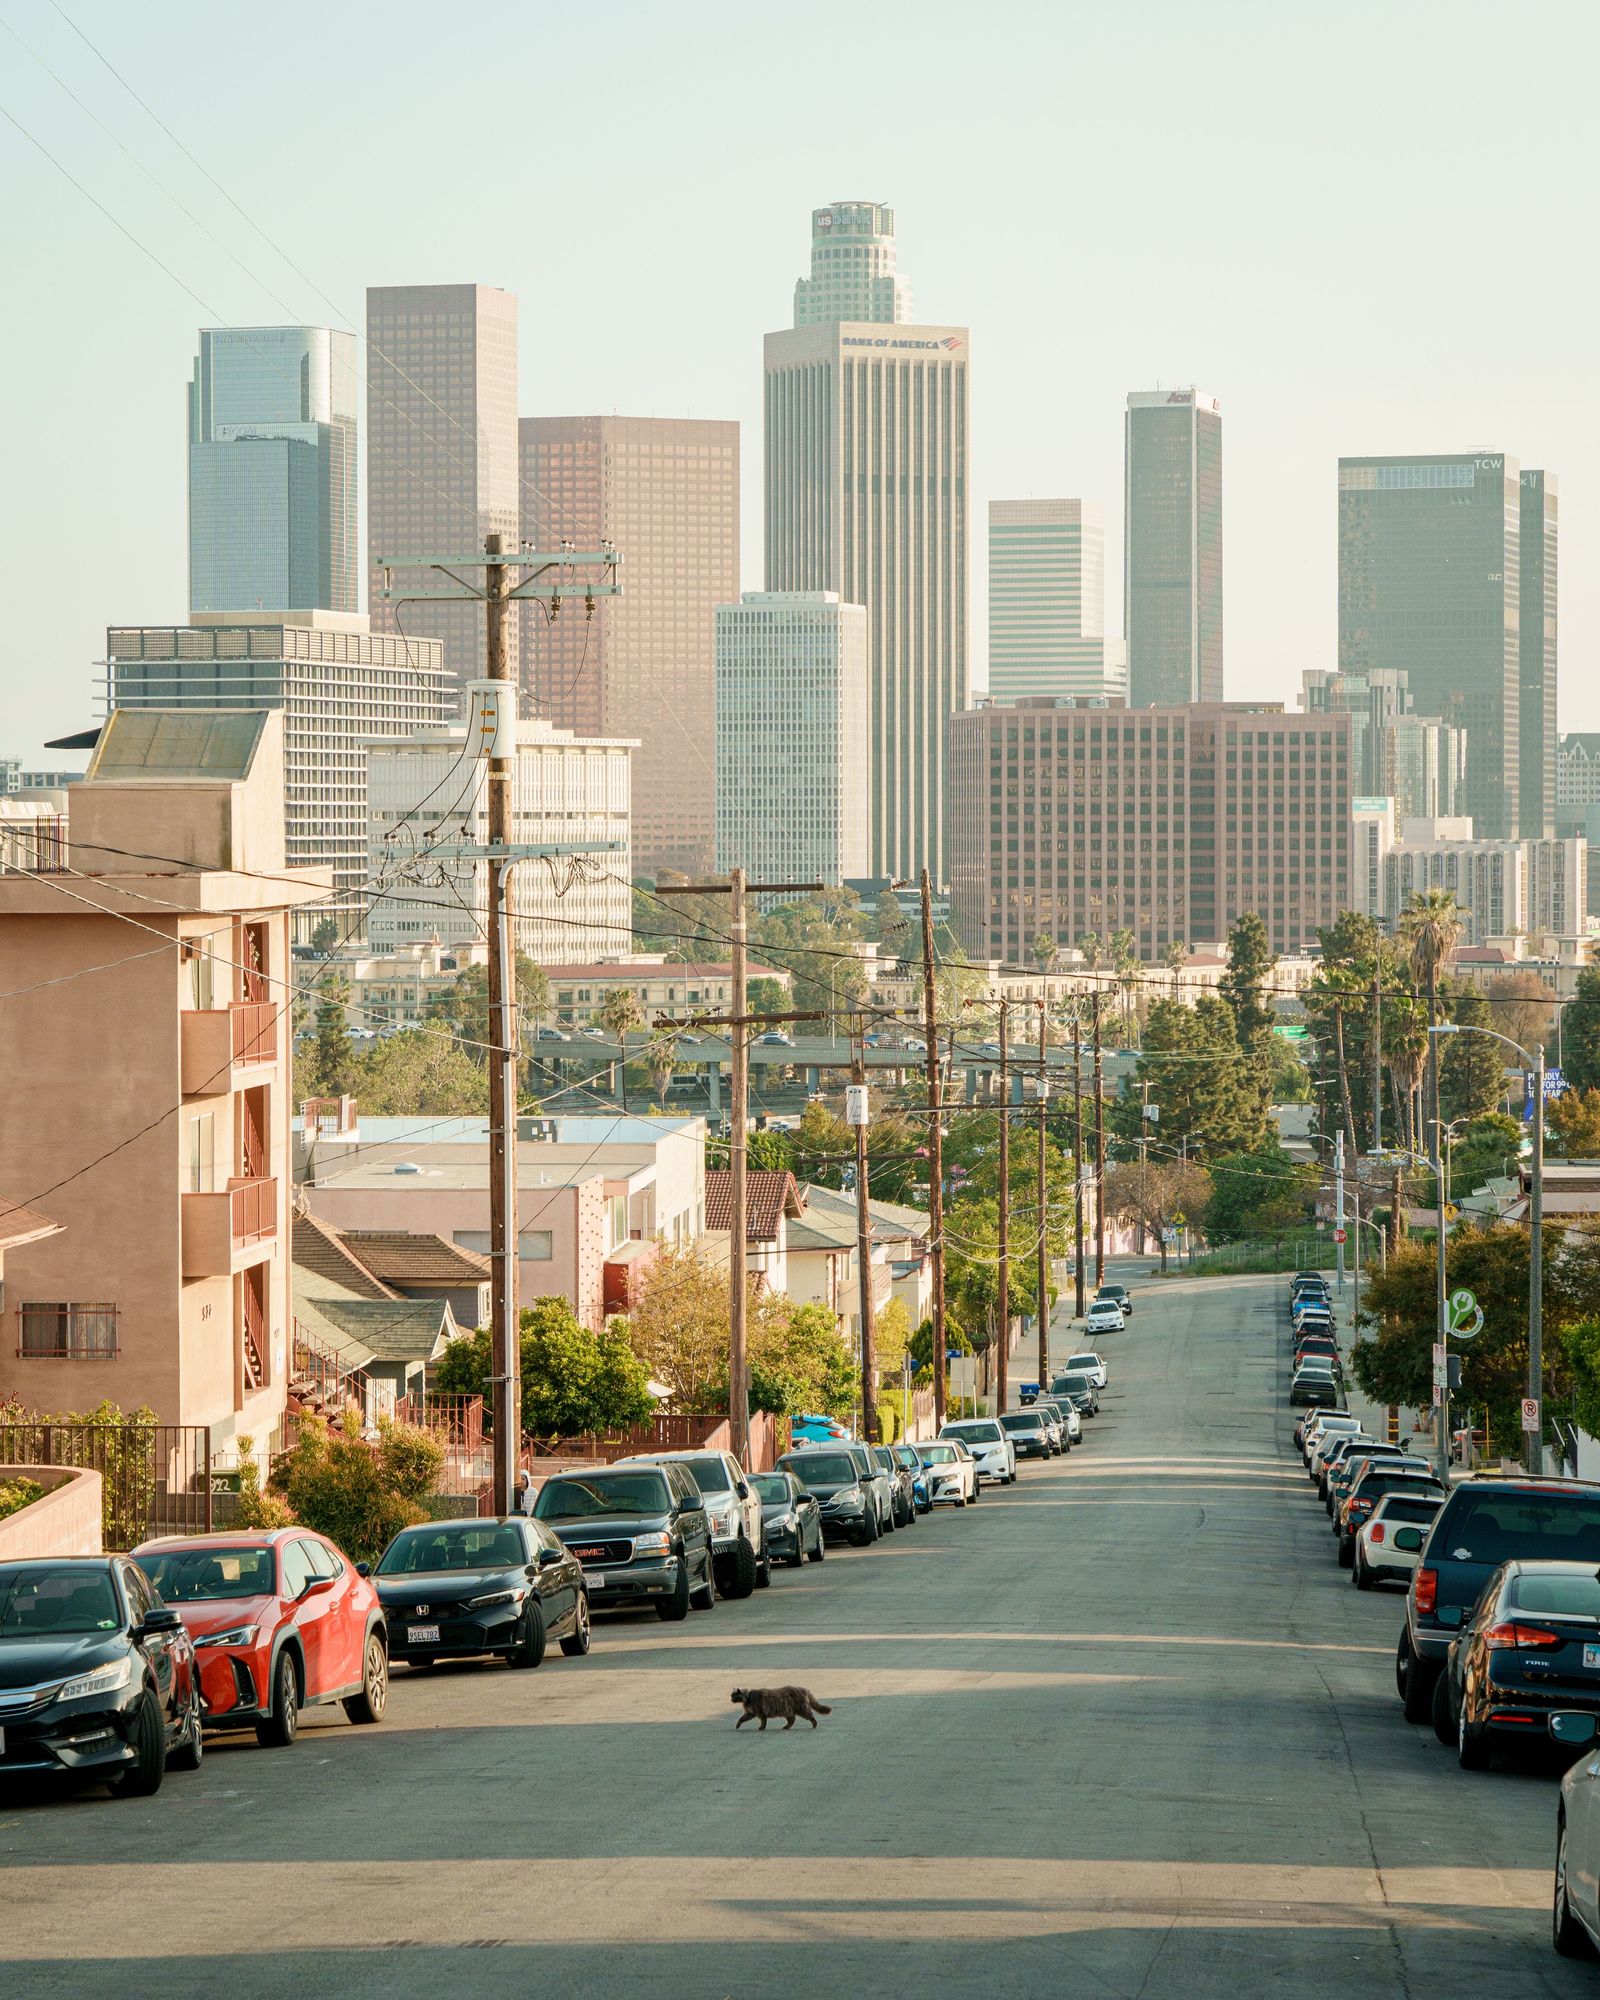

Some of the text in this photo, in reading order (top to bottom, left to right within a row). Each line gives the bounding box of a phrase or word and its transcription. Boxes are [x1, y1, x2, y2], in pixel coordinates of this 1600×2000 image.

[843, 337, 939, 349] BANK OF AMERICA
[1474, 459, 1502, 469] TCW
[1528, 1072, 1560, 1081] PUDLY
[574, 1547, 605, 1557] GMC
